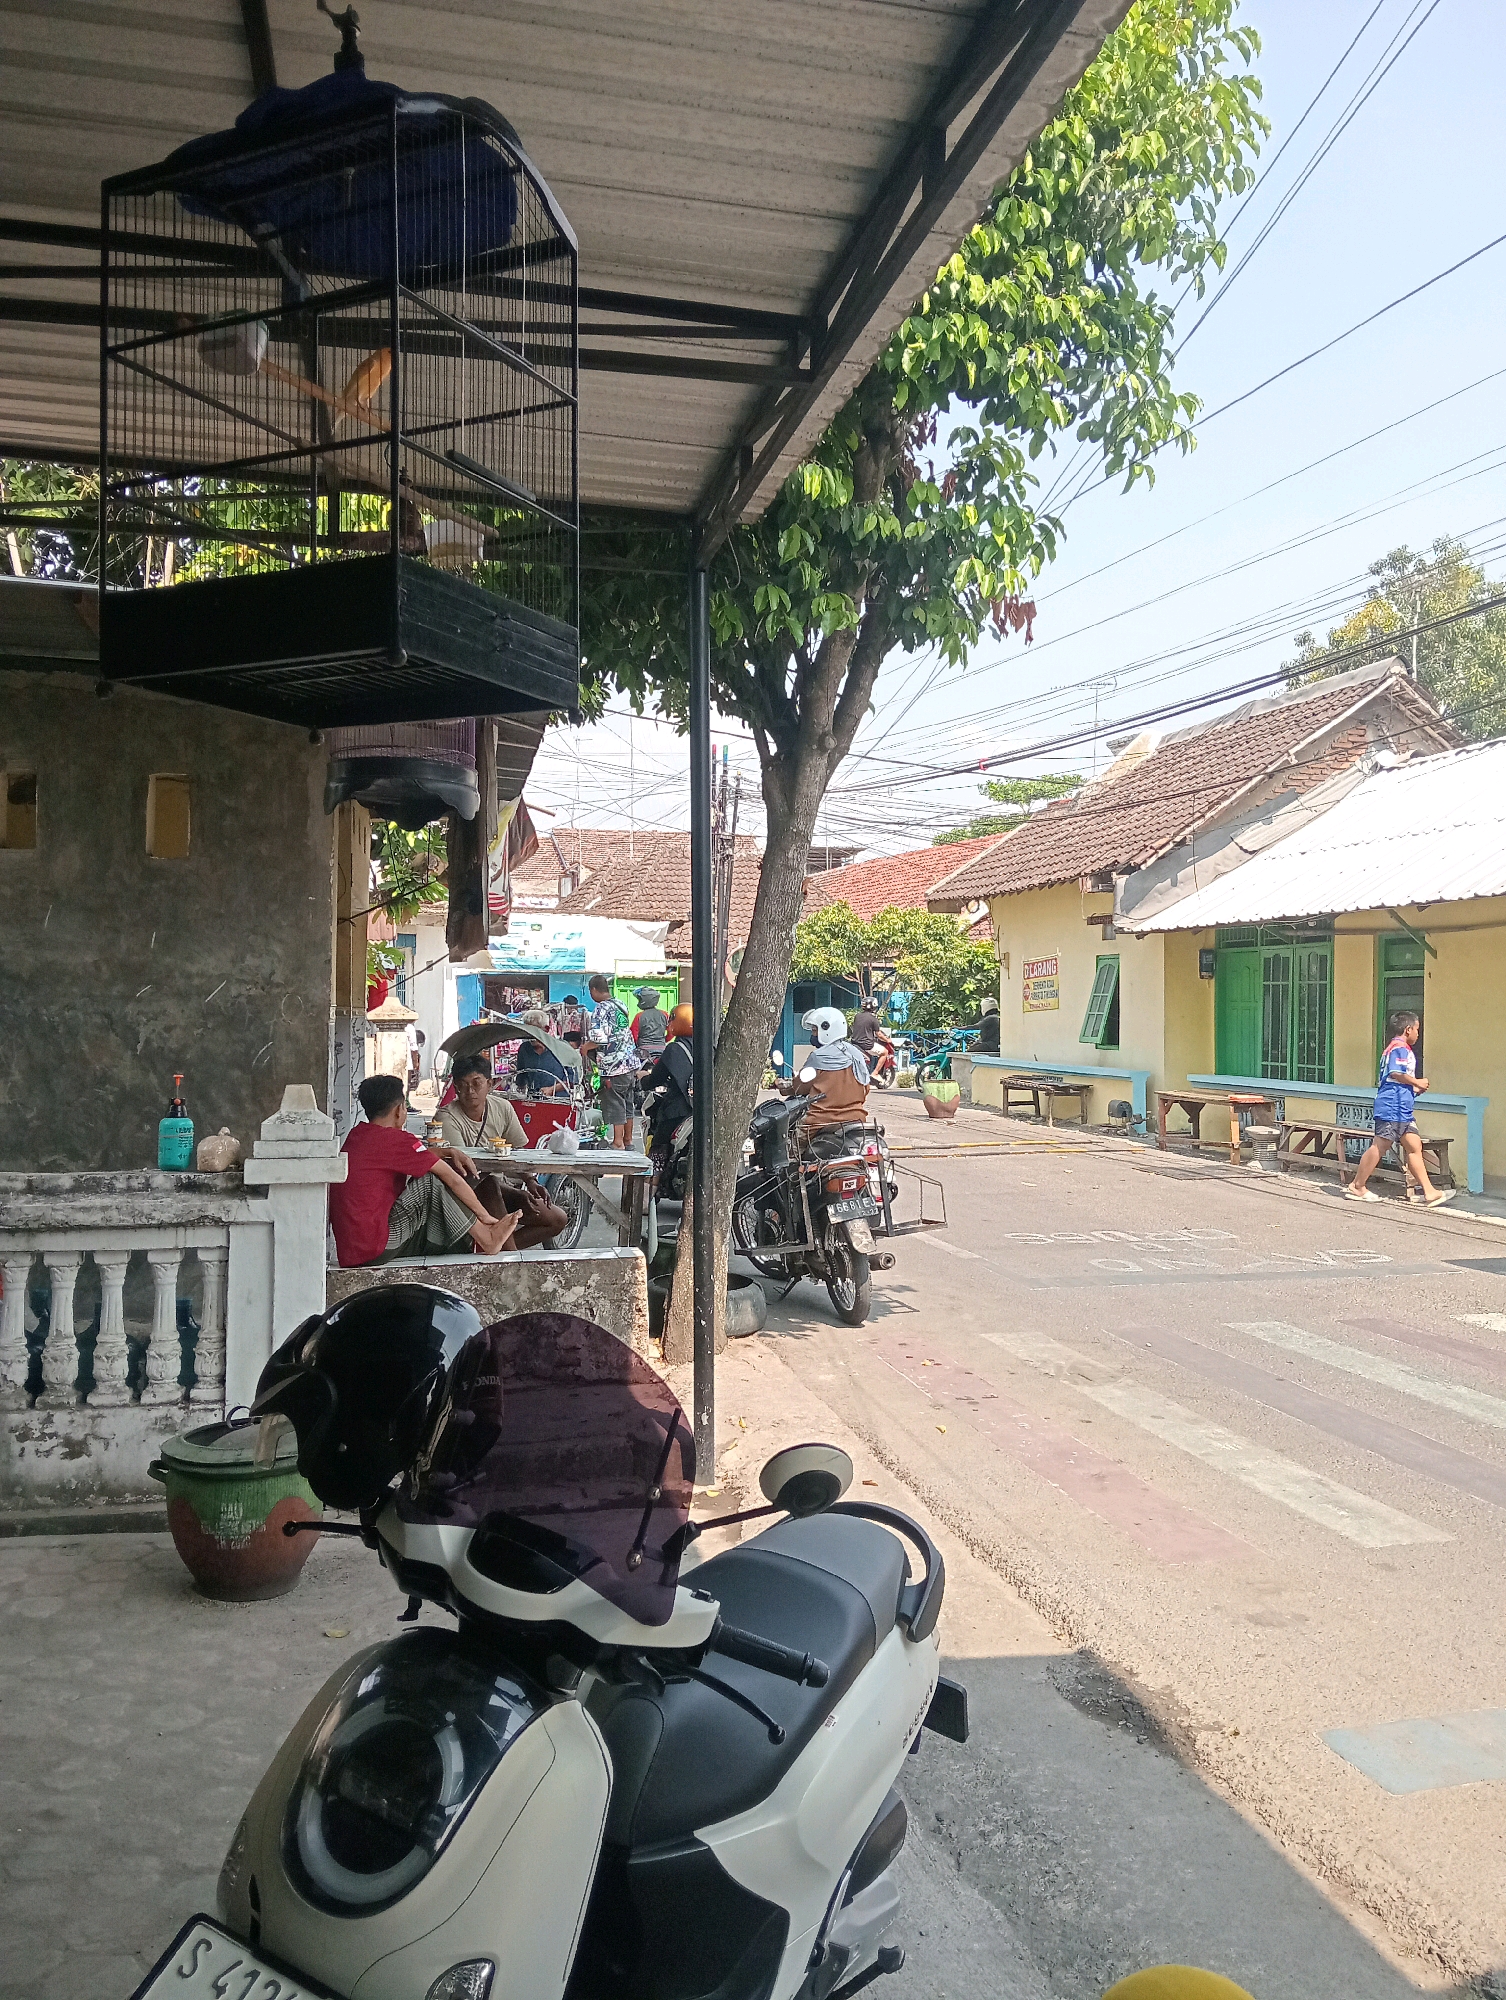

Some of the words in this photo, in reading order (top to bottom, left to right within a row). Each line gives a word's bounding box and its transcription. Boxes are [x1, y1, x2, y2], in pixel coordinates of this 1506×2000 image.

[827, 1204, 835, 1215] W
[836, 1199, 861, 1213] 6681
[177, 1938, 213, 1979] S
[211, 1959, 299, 2000] 412
